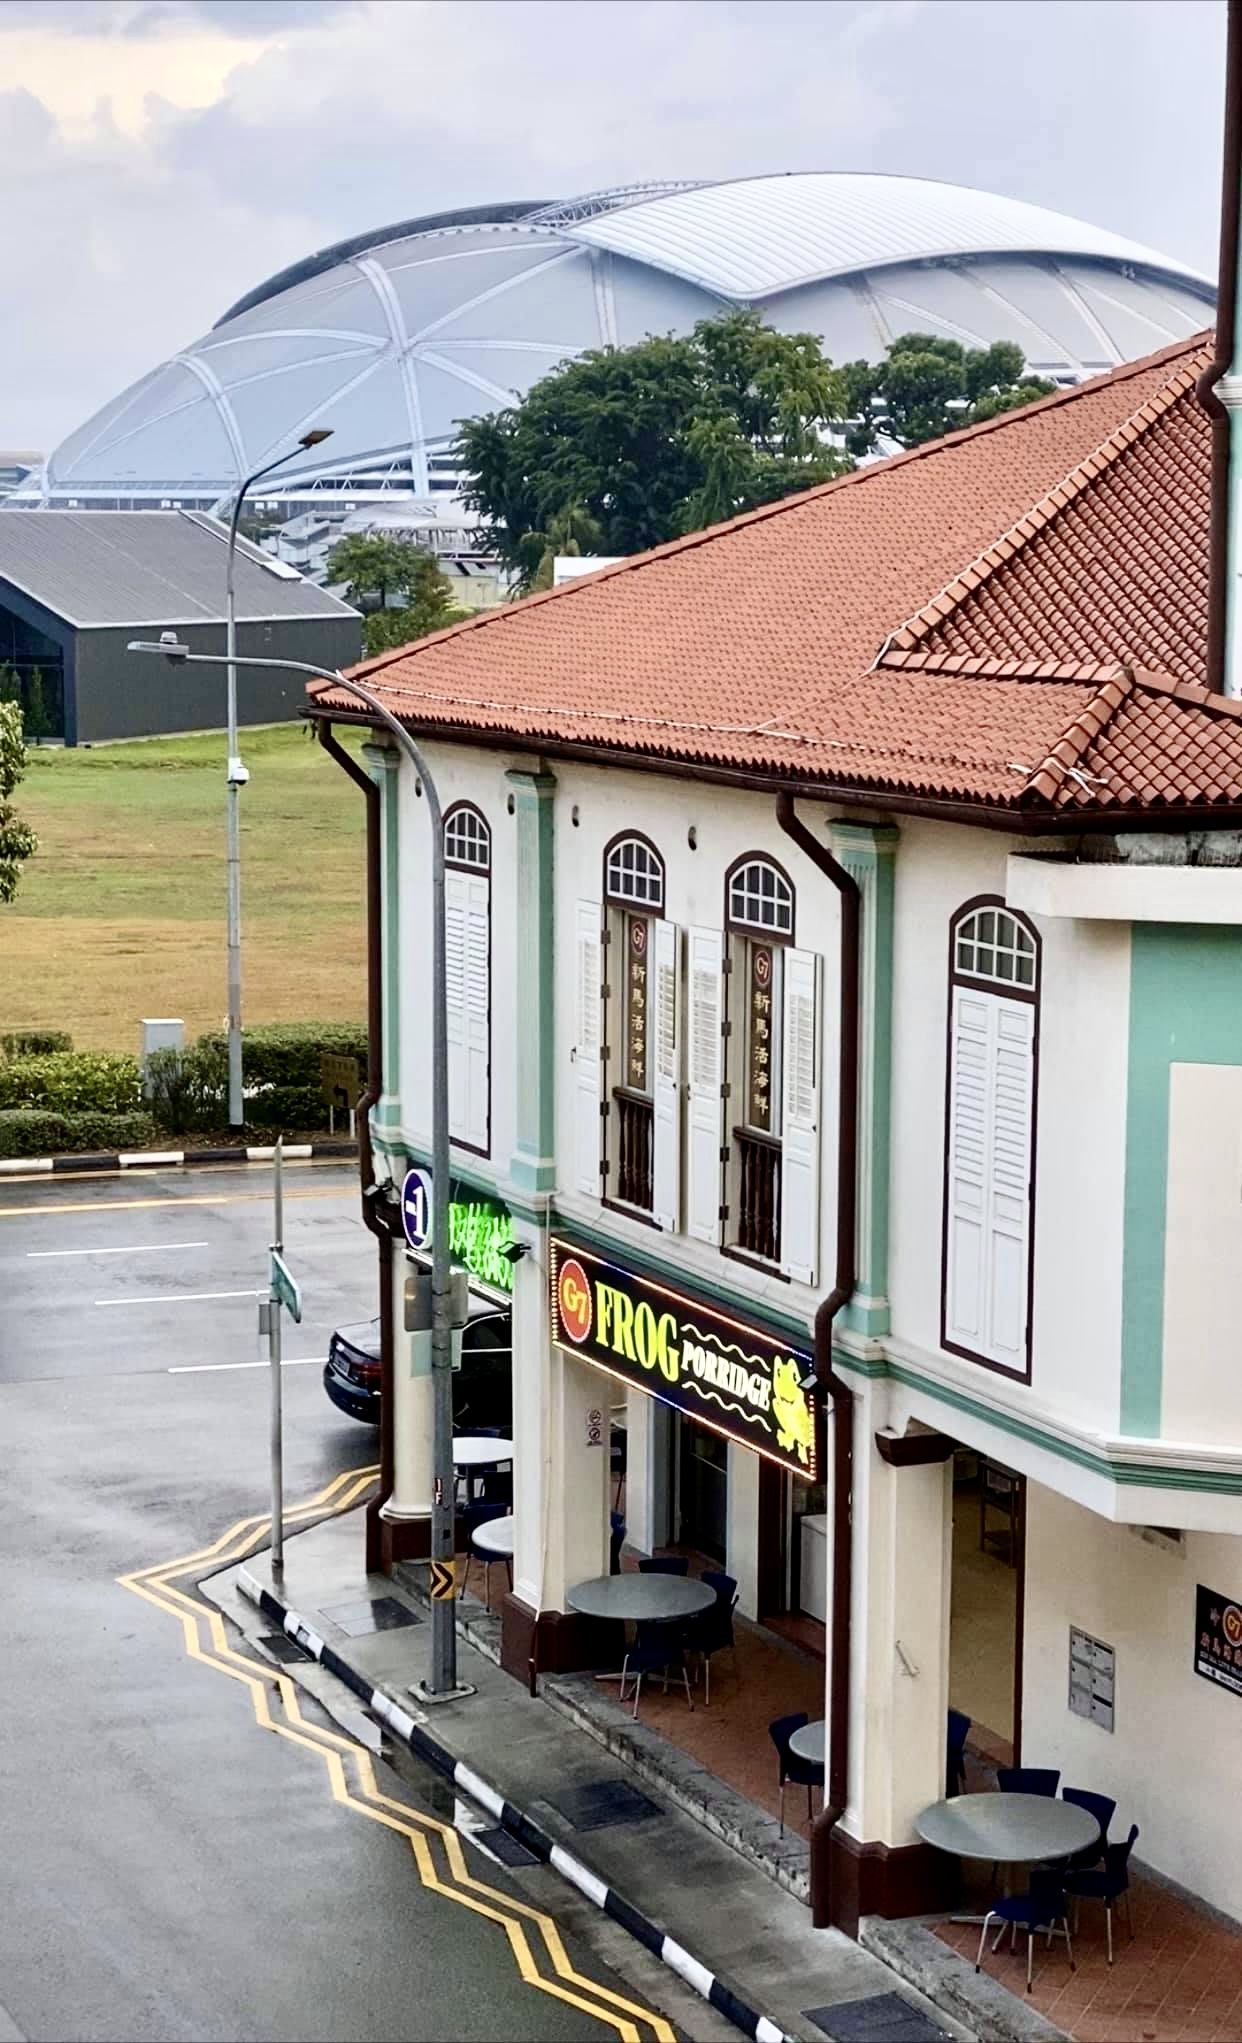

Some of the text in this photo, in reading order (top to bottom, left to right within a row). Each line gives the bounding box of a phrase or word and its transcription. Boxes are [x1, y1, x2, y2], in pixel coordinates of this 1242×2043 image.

[563, 1277, 772, 1412] G7 FROG PORRIDGE
